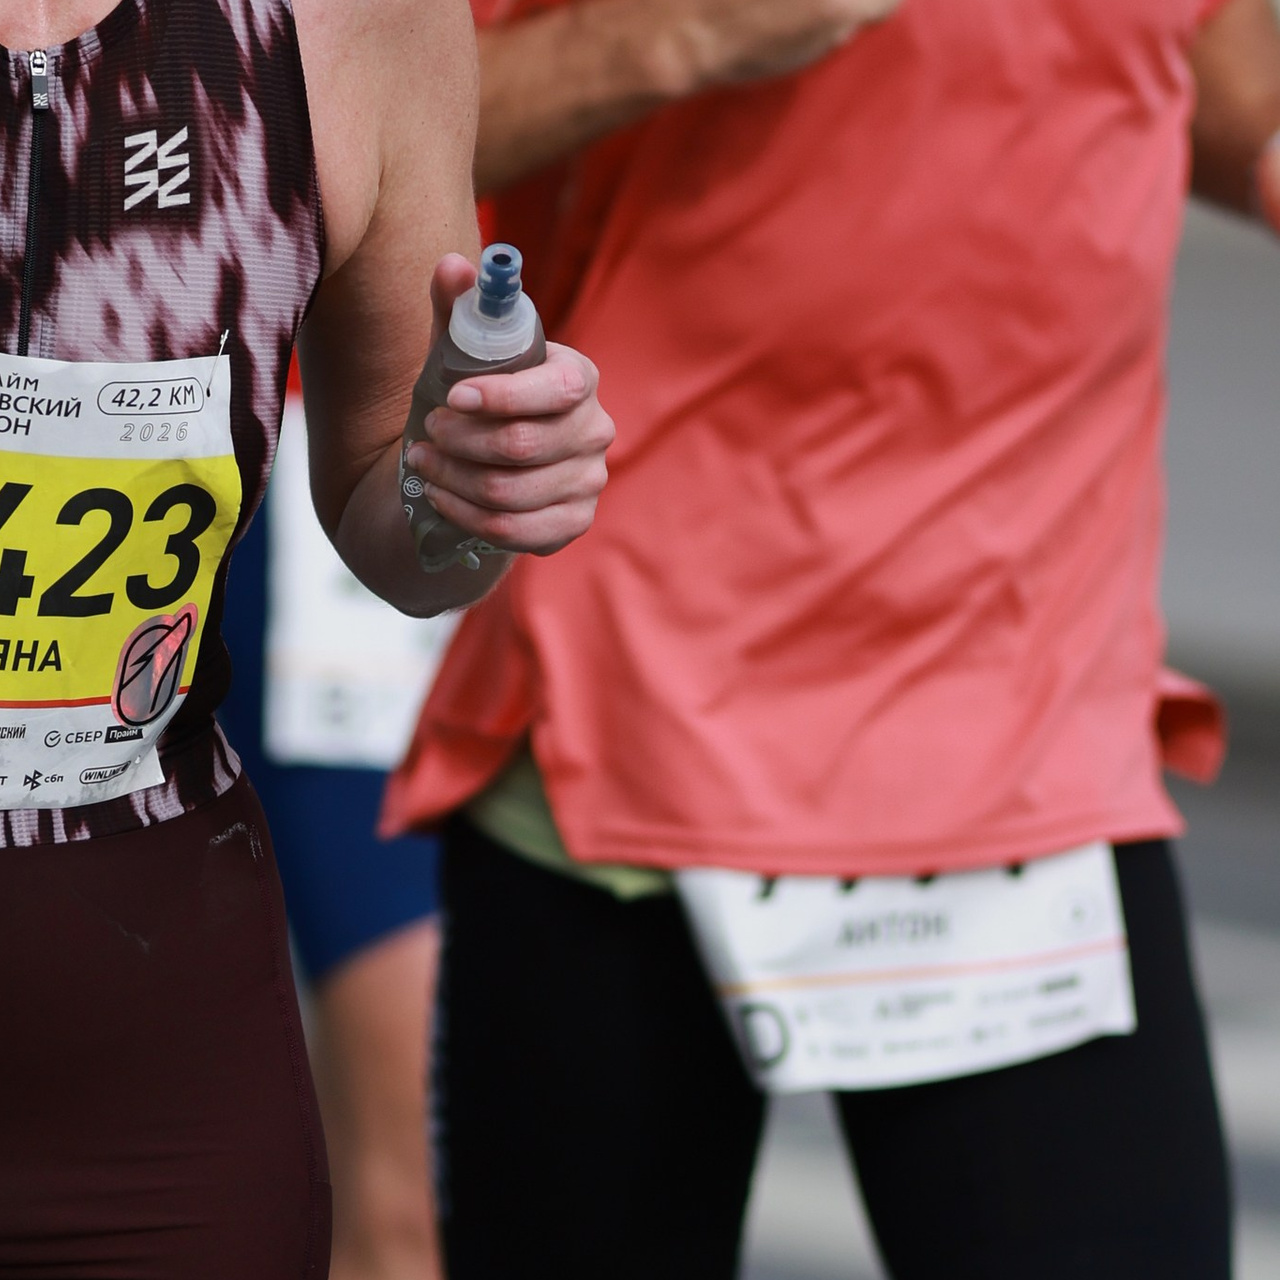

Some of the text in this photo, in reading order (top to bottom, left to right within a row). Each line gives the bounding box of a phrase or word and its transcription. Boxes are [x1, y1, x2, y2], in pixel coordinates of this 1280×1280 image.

[111, 388, 162, 410] 42,2
[119, 421, 189, 441] 2026
[65, 730, 103, 744] СБЕР
